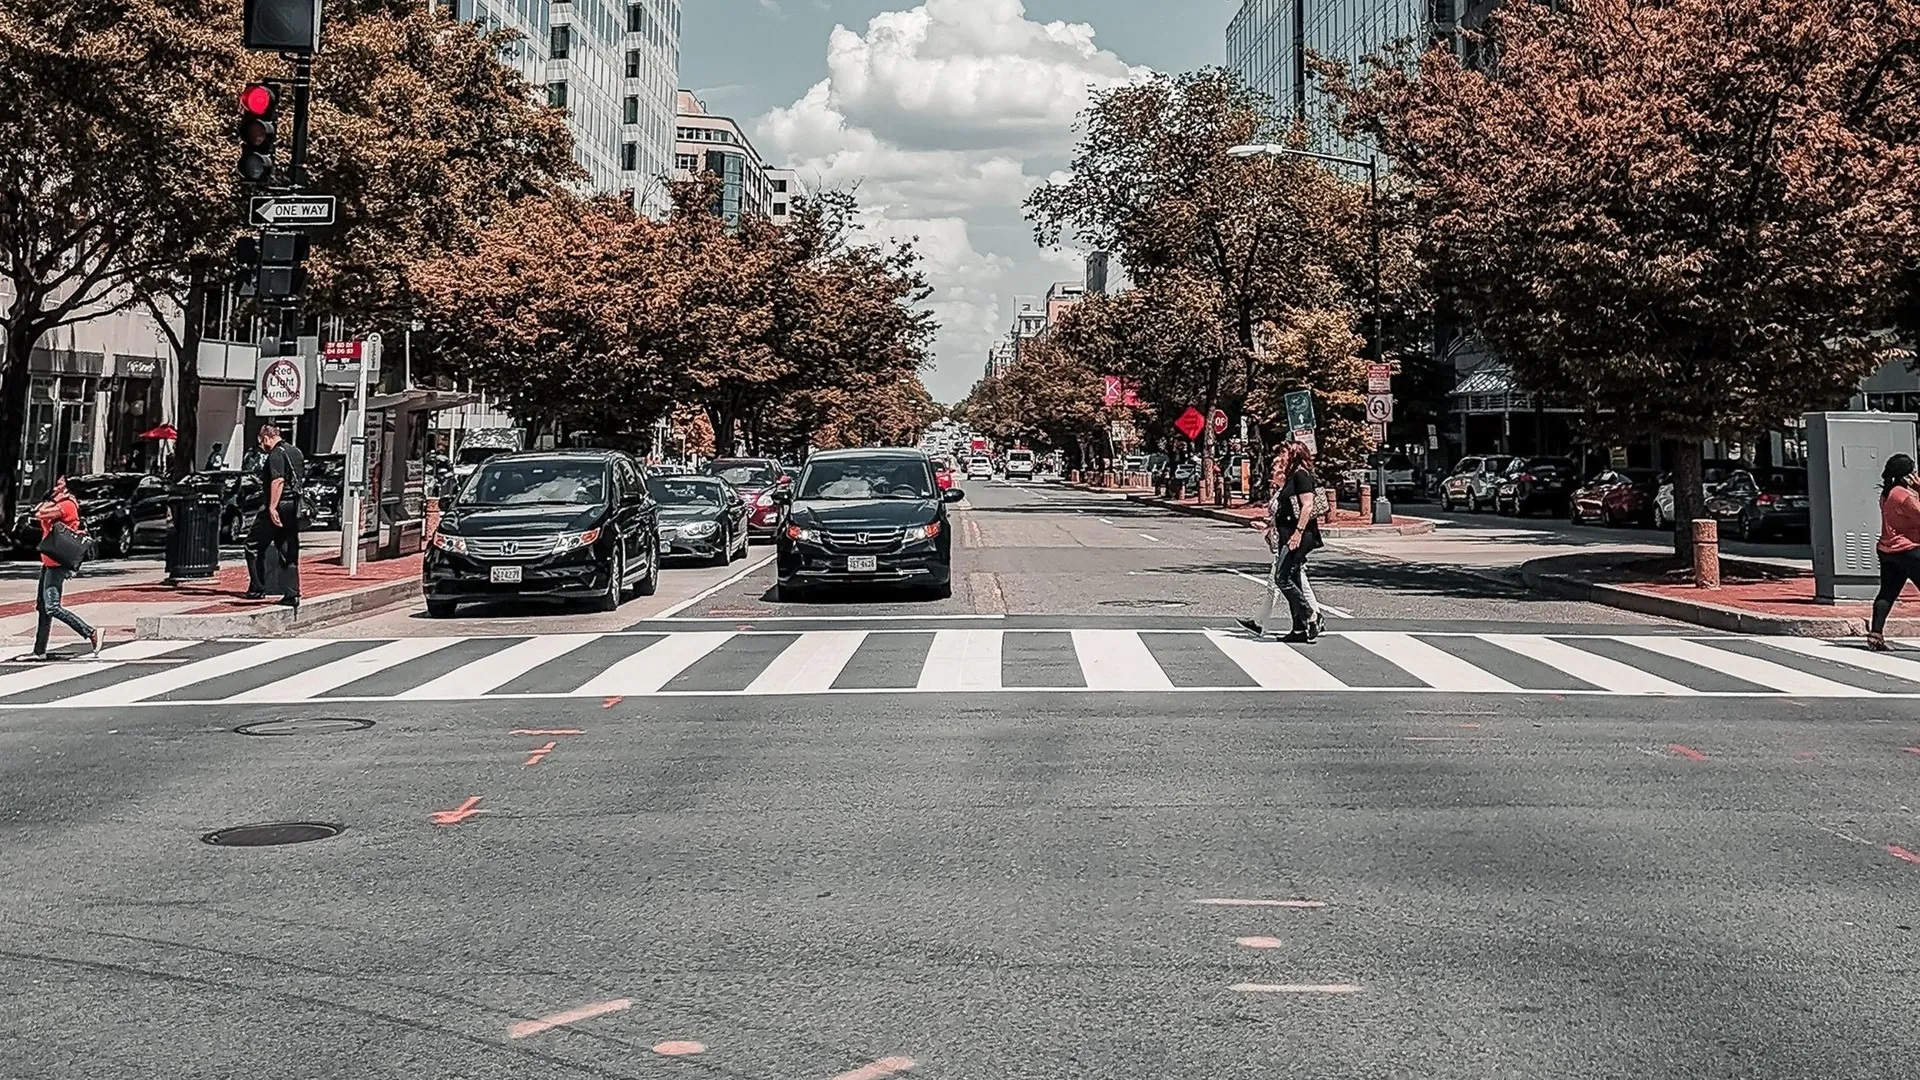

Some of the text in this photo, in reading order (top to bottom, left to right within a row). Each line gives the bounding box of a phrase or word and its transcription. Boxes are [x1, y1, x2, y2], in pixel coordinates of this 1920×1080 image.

[275, 204, 325, 216] ONE WAY
[273, 365, 292, 375] Red
[269, 377, 295, 389] Light
[1105, 379, 1120, 396] K
